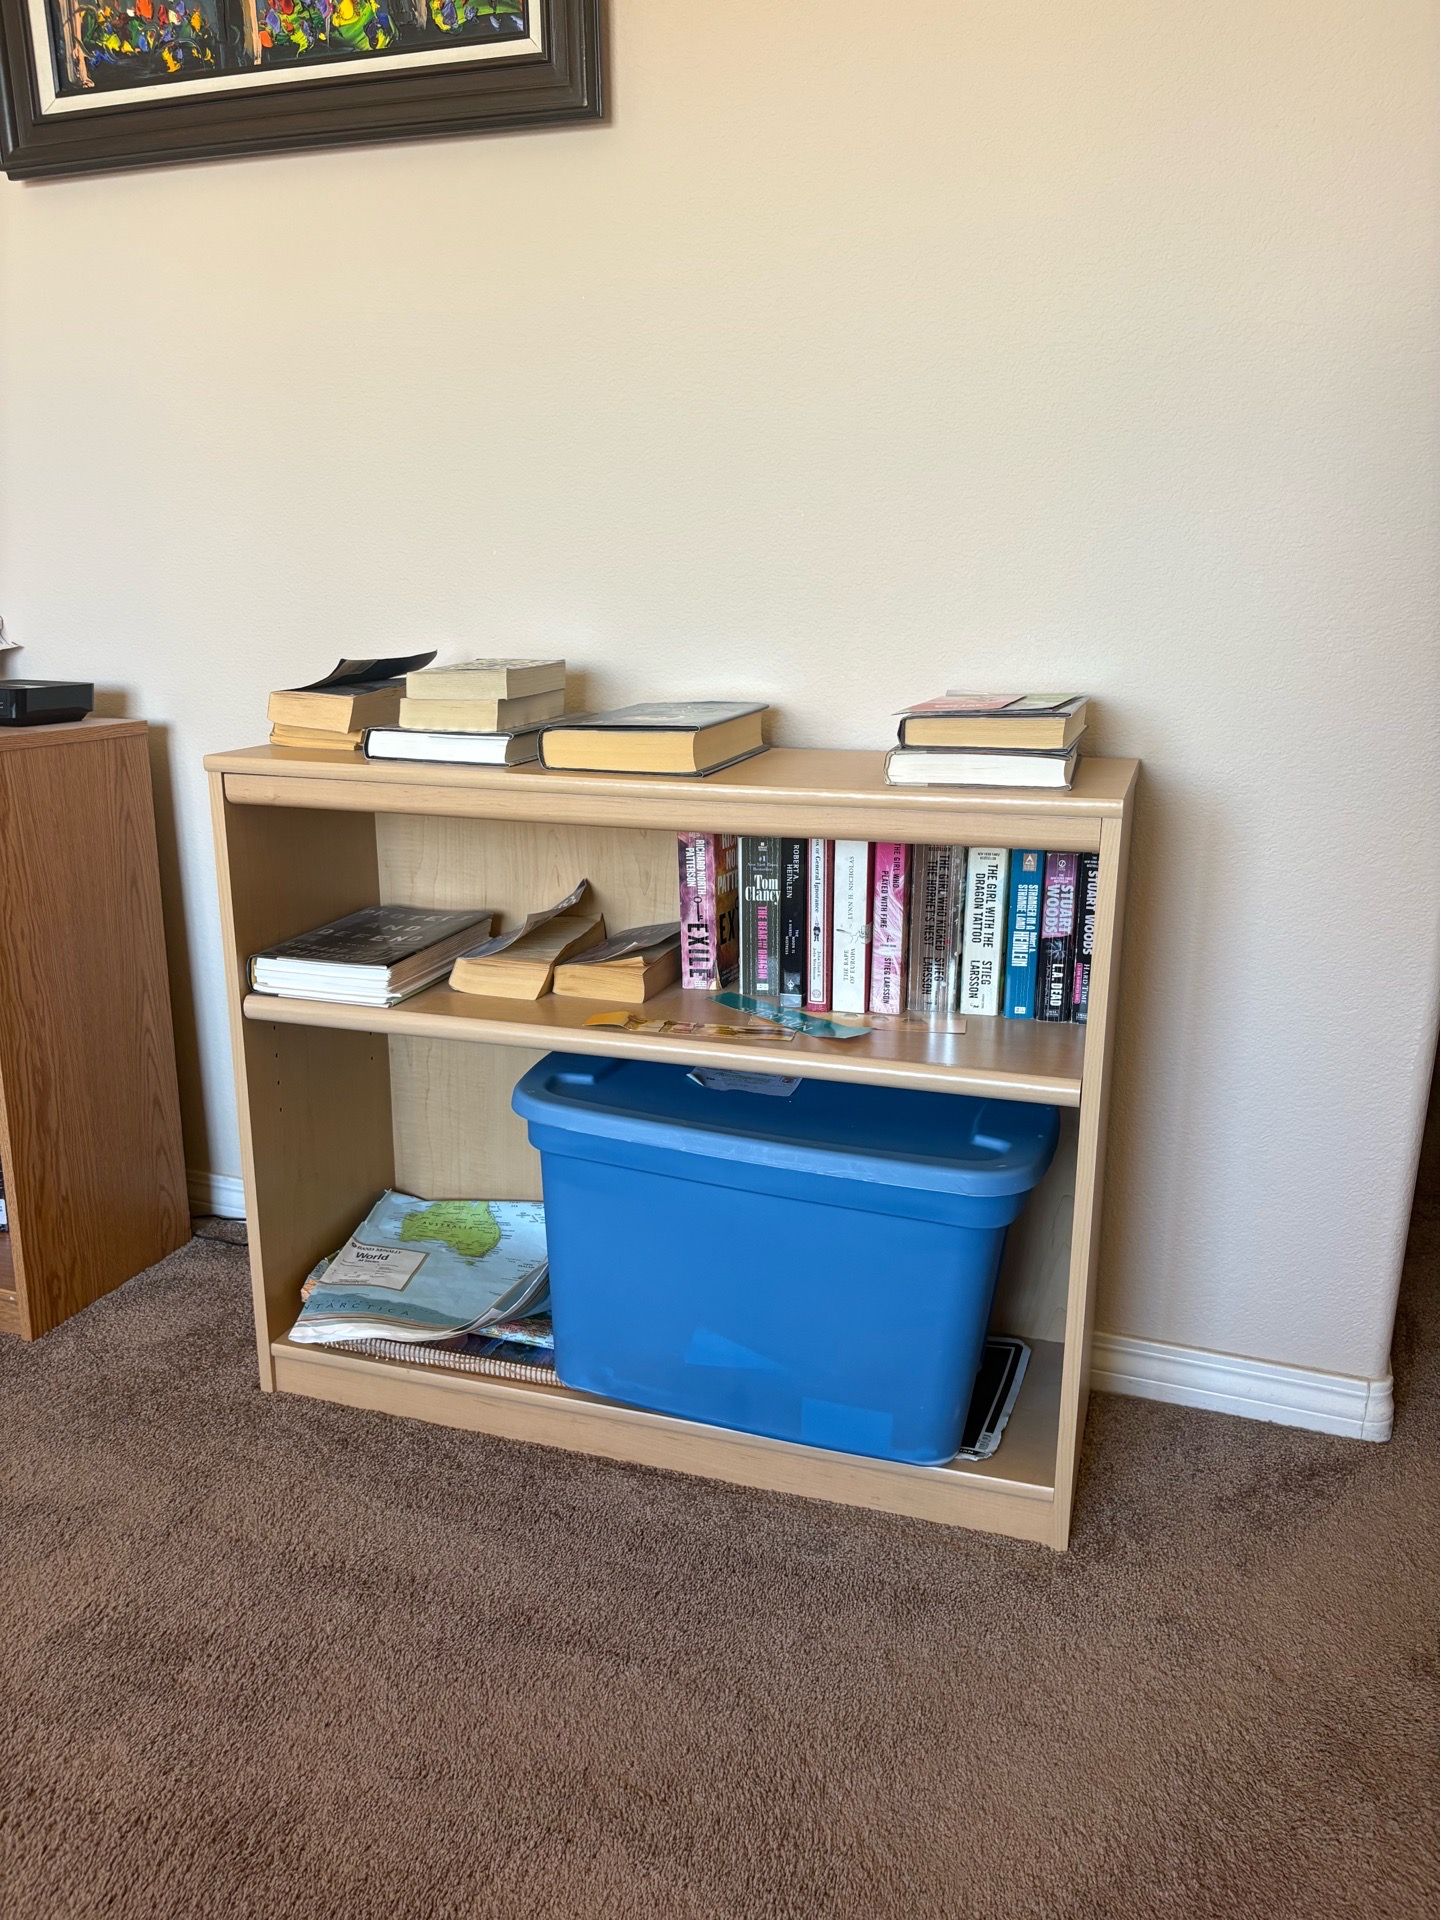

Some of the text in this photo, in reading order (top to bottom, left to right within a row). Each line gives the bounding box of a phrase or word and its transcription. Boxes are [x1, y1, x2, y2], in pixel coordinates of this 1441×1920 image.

[695, 840, 706, 870] RICHARD
[792, 844, 800, 871] ROBERT
[939, 854, 950, 871] THE
[686, 848, 696, 887] PATTERSON
[988, 864, 998, 880] THE
[697, 871, 706, 895] NORTH
[754, 874, 778, 890] Tom
[892, 872, 900, 888] WHO
[938, 874, 948, 894] GIRL
[1085, 870, 1098, 911] STUART
[745, 886, 781, 905] Clancy
[880, 870, 889, 928] PLAYED WITH FIRE
[986, 882, 997, 904] GIRL
[1026, 884, 1038, 916] STRANGER
[758, 906, 768, 919] THE
[937, 897, 948, 917] WHO
[972, 873, 986, 943] DRAGON TATTOO
[984, 906, 996, 929] WITH
[1015, 884, 1028, 929] STRANGE LAND
[1044, 884, 1060, 933] WOODS
[1058, 884, 1074, 933] STUART
[317, 928, 424, 942] DEFEND
[369, 922, 423, 932] AND
[758, 921, 768, 939] BEAR
[922, 860, 938, 995] THE HORNET'S NEST LARSSON
[935, 920, 947, 951] KICKED
[1082, 914, 1096, 955] WOODS
[687, 923, 710, 978] EXILE
[983, 931, 994, 948] THE
[1012, 930, 1030, 966] HEINLEIN
[1029, 932, 1038, 947] Robert
[757, 949, 768, 979] DRAGON
[884, 957, 892, 975] STIEG
[934, 957, 944, 982] STIEG
[980, 960, 992, 985] STIEG
[1051, 963, 1064, 981] L.A.
[1082, 963, 1090, 985] HARD
[849, 975, 856, 984] OF
[882, 977, 890, 1004] LARSSON
[969, 960, 981, 999] LARSSON
[1050, 982, 1063, 1007] DEAD
[423, 1221, 472, 1230] AUSTRALIA
[356, 1252, 390, 1261] World
[304, 1301, 409, 1316] NTARCTICA
